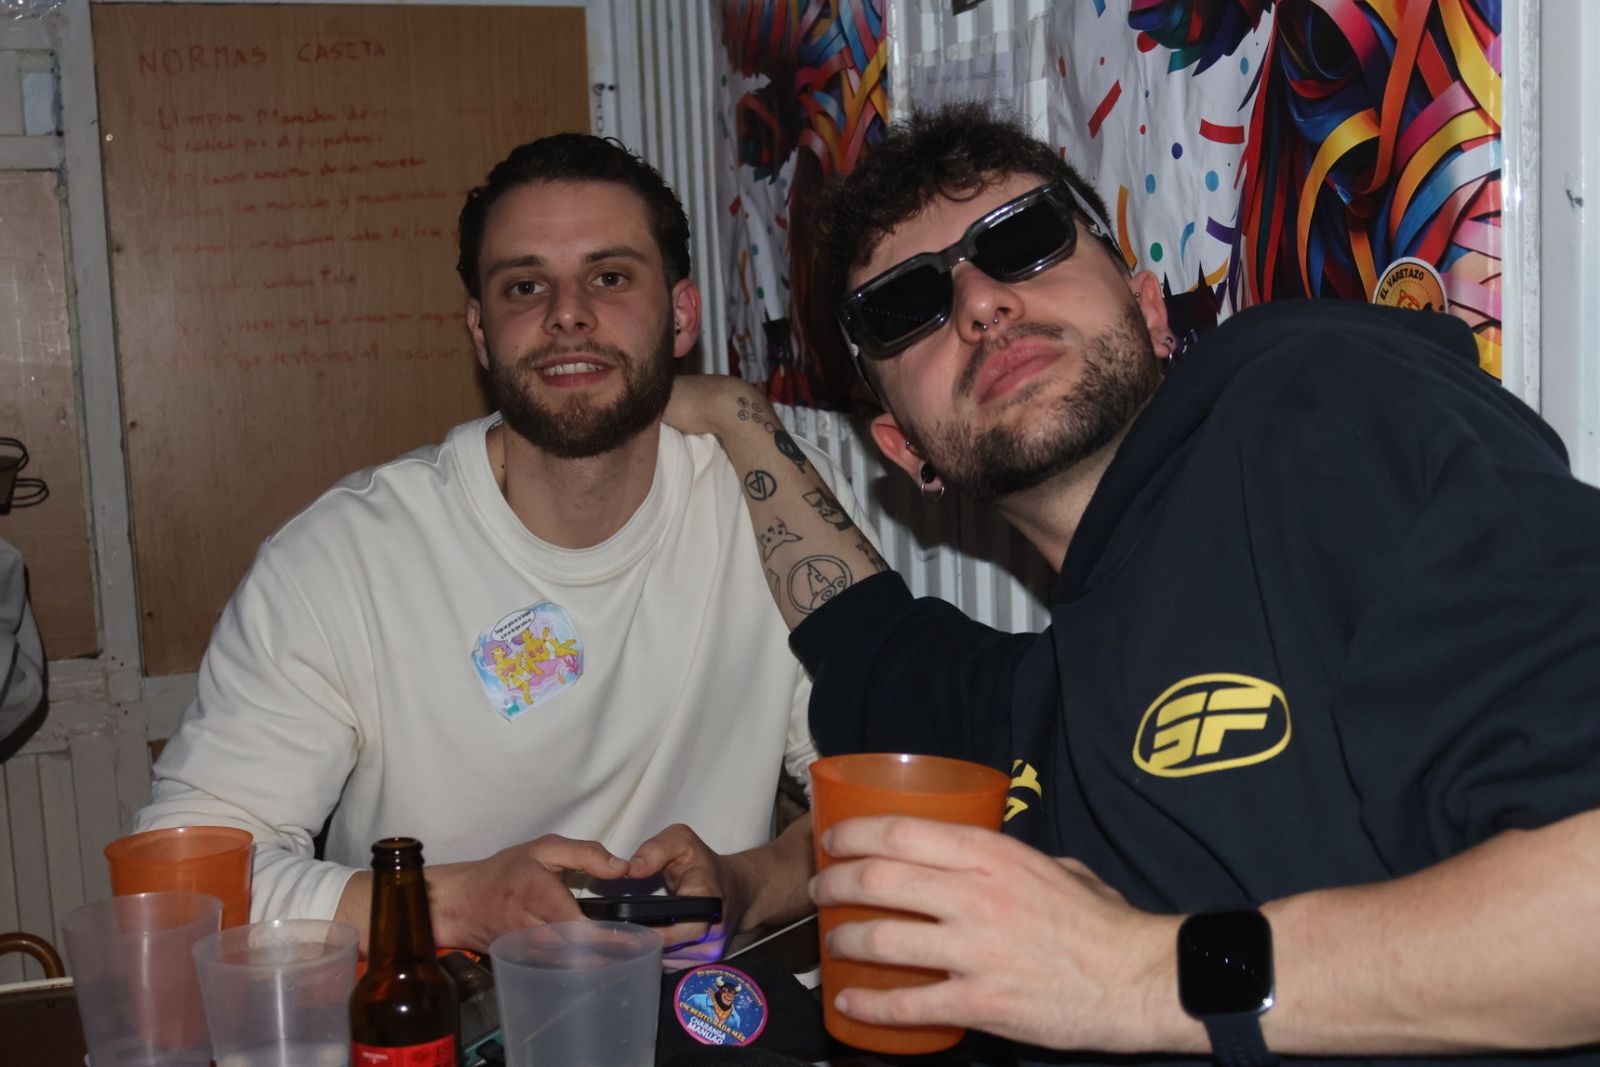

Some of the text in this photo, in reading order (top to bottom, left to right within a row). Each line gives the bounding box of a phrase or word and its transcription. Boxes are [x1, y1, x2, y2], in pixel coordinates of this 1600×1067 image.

[138, 40, 387, 76] NORMAS CASETA
[1380, 268, 1425, 301] EL VARETAZO
[1147, 686, 1277, 770] SF
[690, 1016, 726, 1041] CHARANGA
